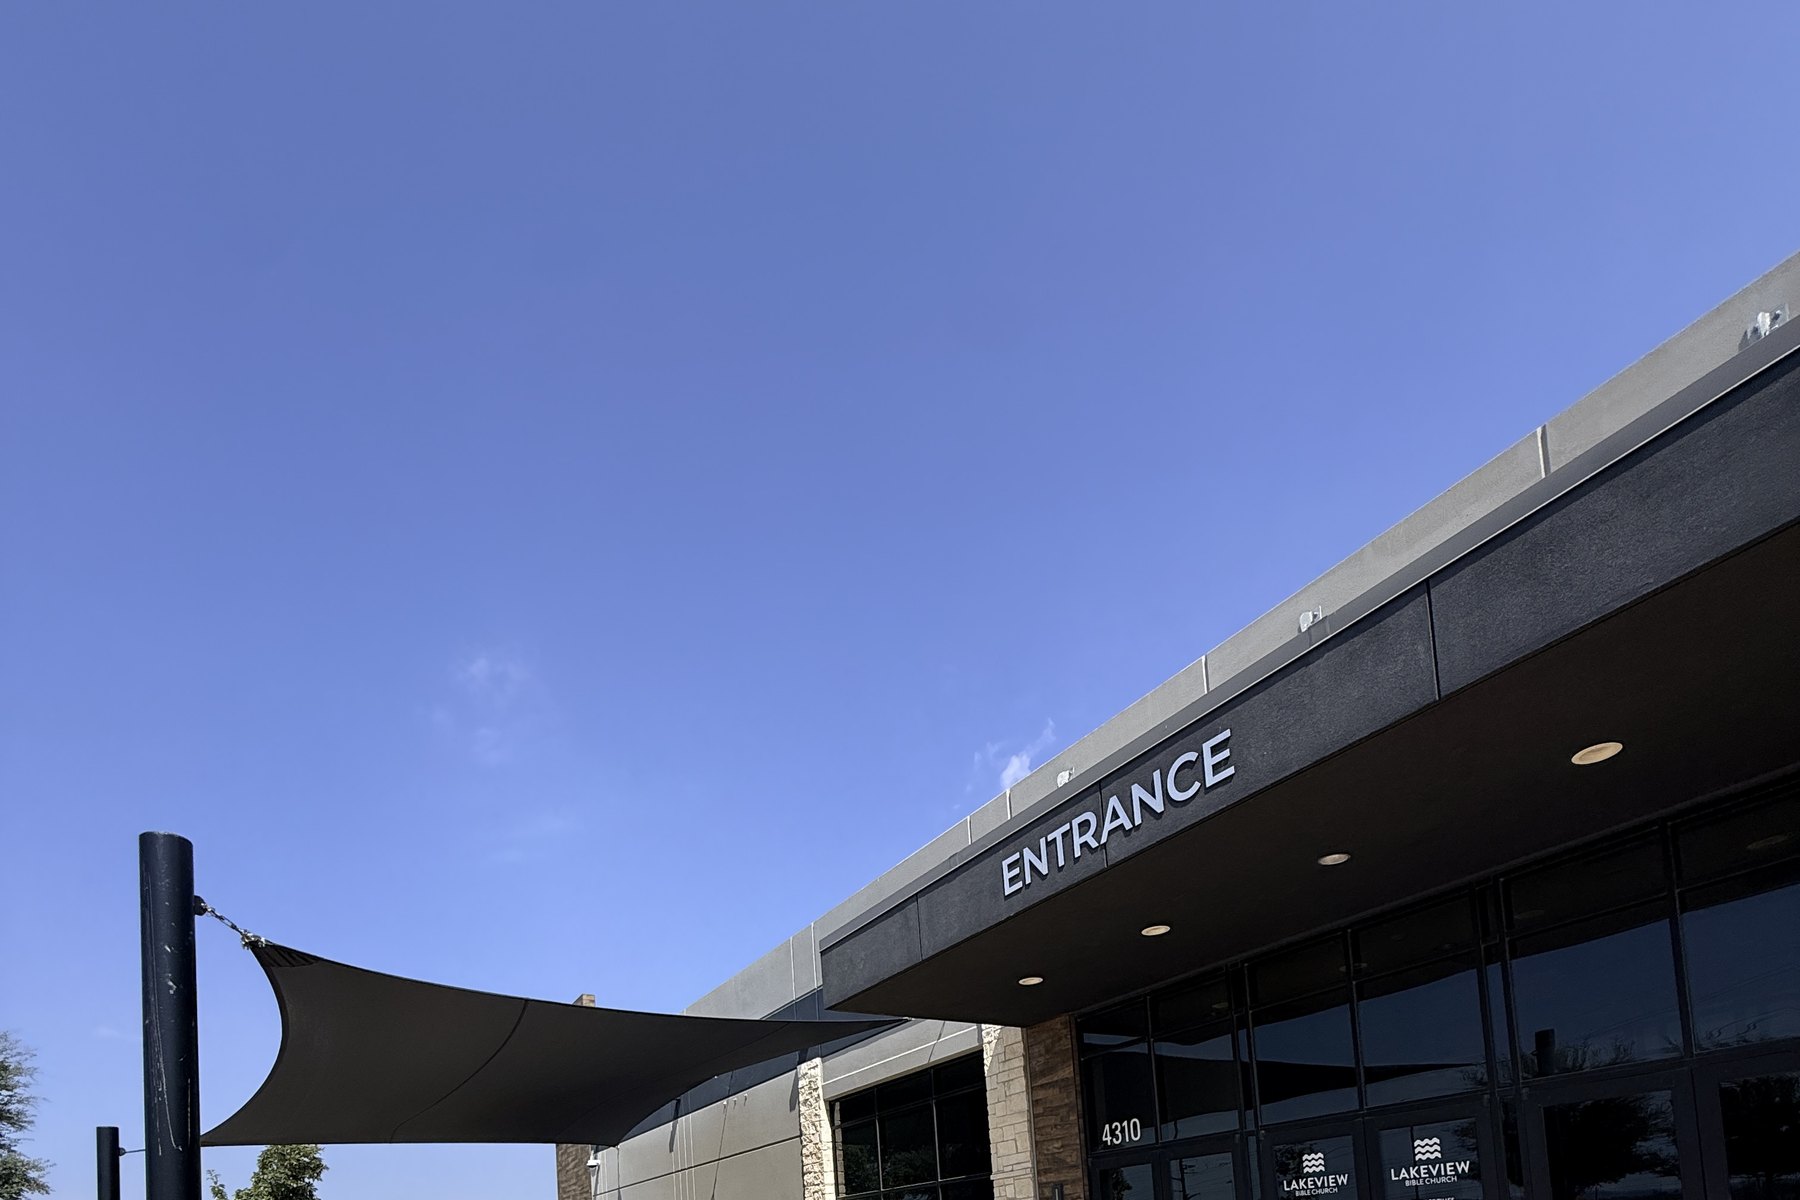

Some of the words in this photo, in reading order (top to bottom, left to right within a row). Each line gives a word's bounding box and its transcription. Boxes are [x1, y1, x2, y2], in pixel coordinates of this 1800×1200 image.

[1001, 728, 1236, 897] ENTRANCE
[1102, 1117, 1141, 1146] 4310
[1390, 1160, 1470, 1181] LAKEVIEW
[1283, 1173, 1349, 1191] LAKEVIEW
[1405, 1178, 1424, 1187] BIBLE
[1425, 1175, 1458, 1185] CHURCH
[1295, 1189, 1311, 1197] BIBLE
[1311, 1187, 1338, 1196] CHURCH
